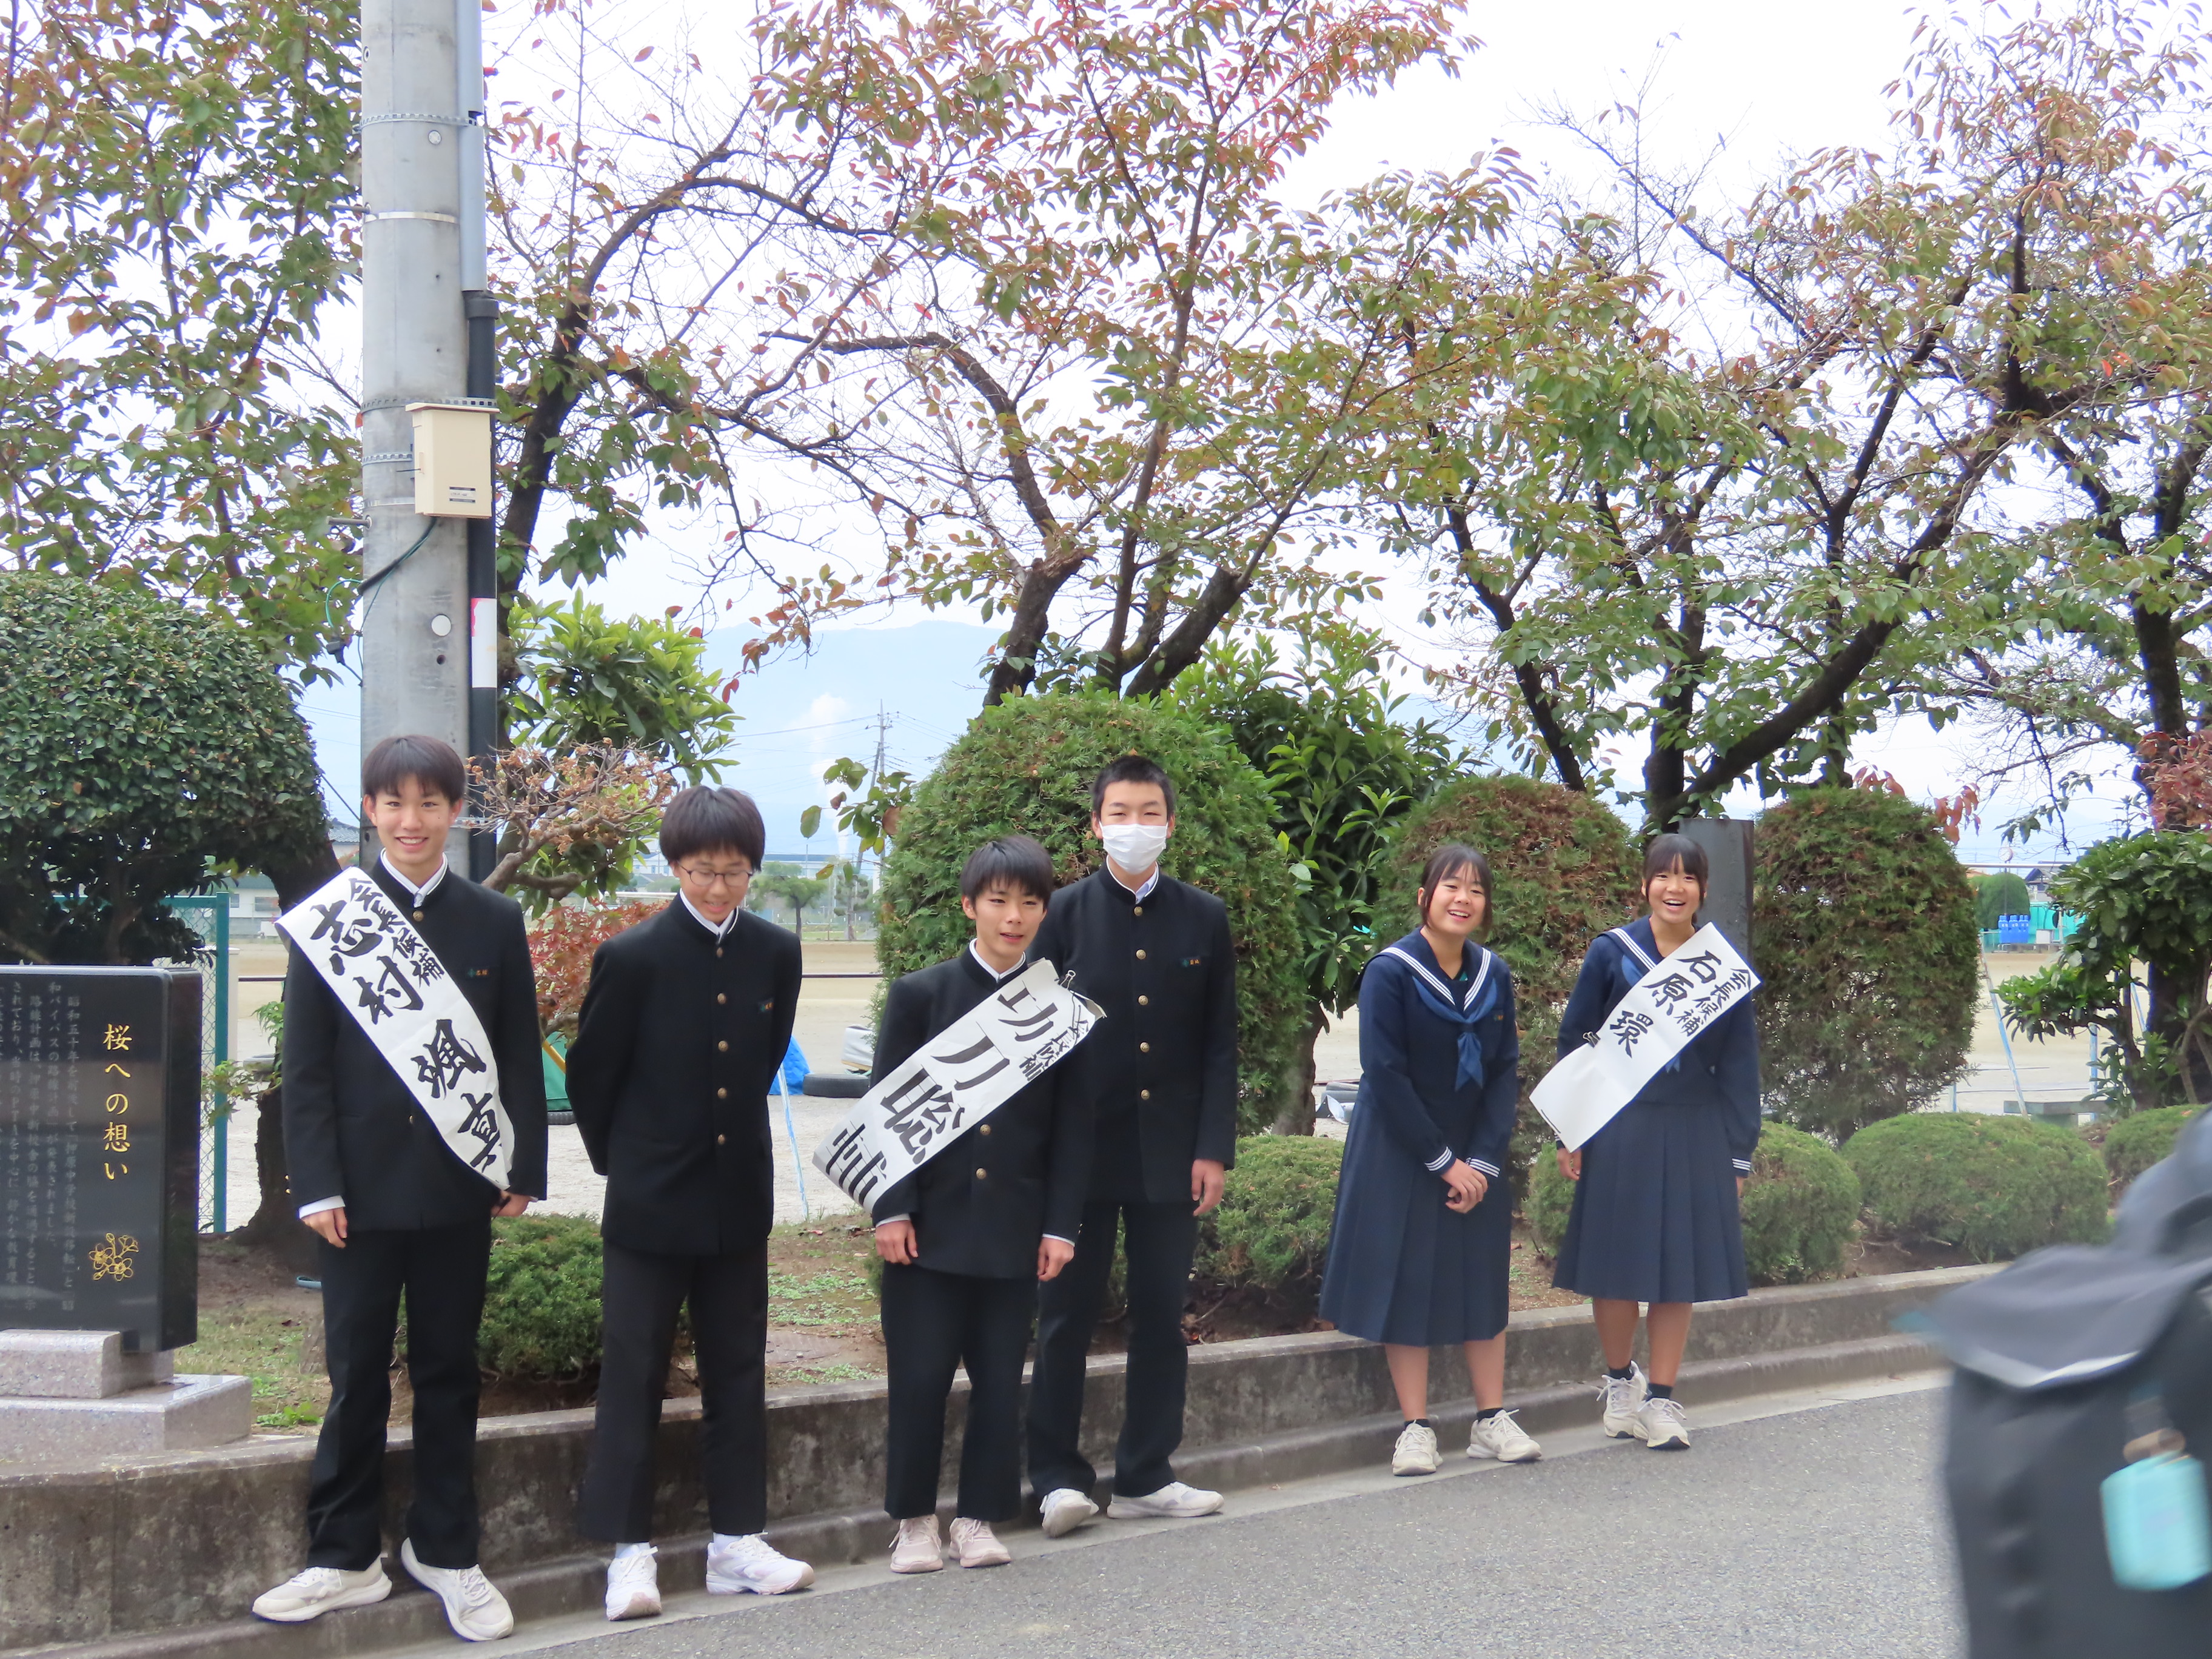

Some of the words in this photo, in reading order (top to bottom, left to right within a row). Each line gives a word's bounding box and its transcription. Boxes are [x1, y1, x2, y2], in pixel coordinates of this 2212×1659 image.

[349, 877, 444, 987] 会長候補
[1674, 968, 1751, 1037] 会長候補
[1019, 1019, 1089, 1082] 会長候補
[103, 1024, 133, 1180] 桜への想い
